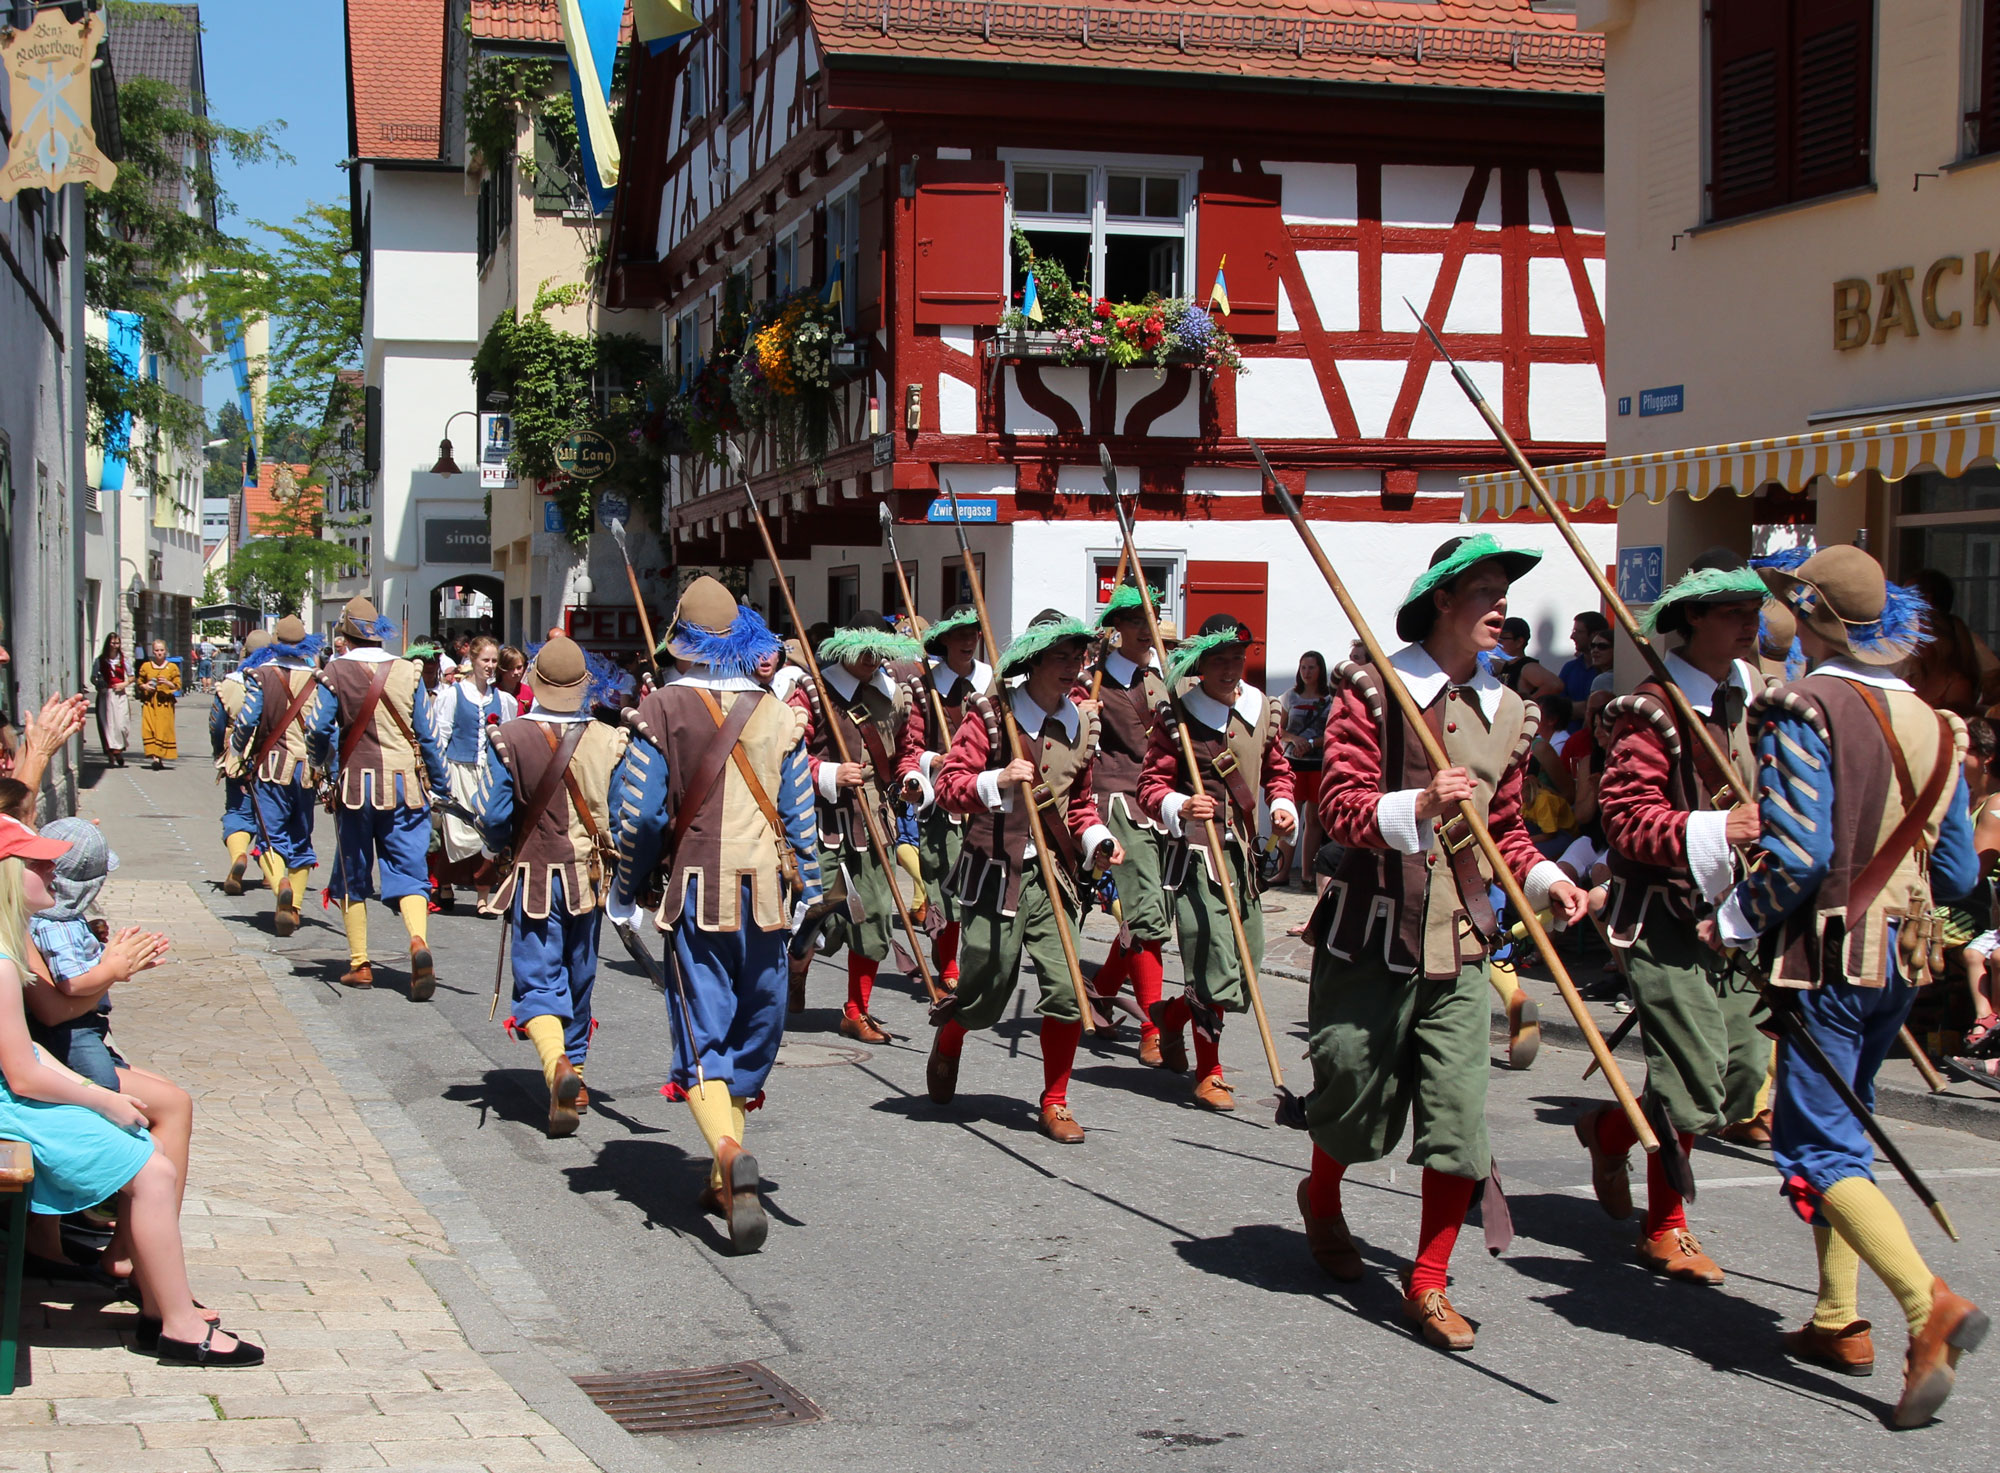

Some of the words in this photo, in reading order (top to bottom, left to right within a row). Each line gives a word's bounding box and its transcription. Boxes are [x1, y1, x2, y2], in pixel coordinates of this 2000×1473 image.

[1619, 399, 1628, 413] 11
[1643, 394, 1679, 411] Pfluggasse
[582, 448, 611, 463] Lang
[933, 502, 992, 519] Zwinergasse
